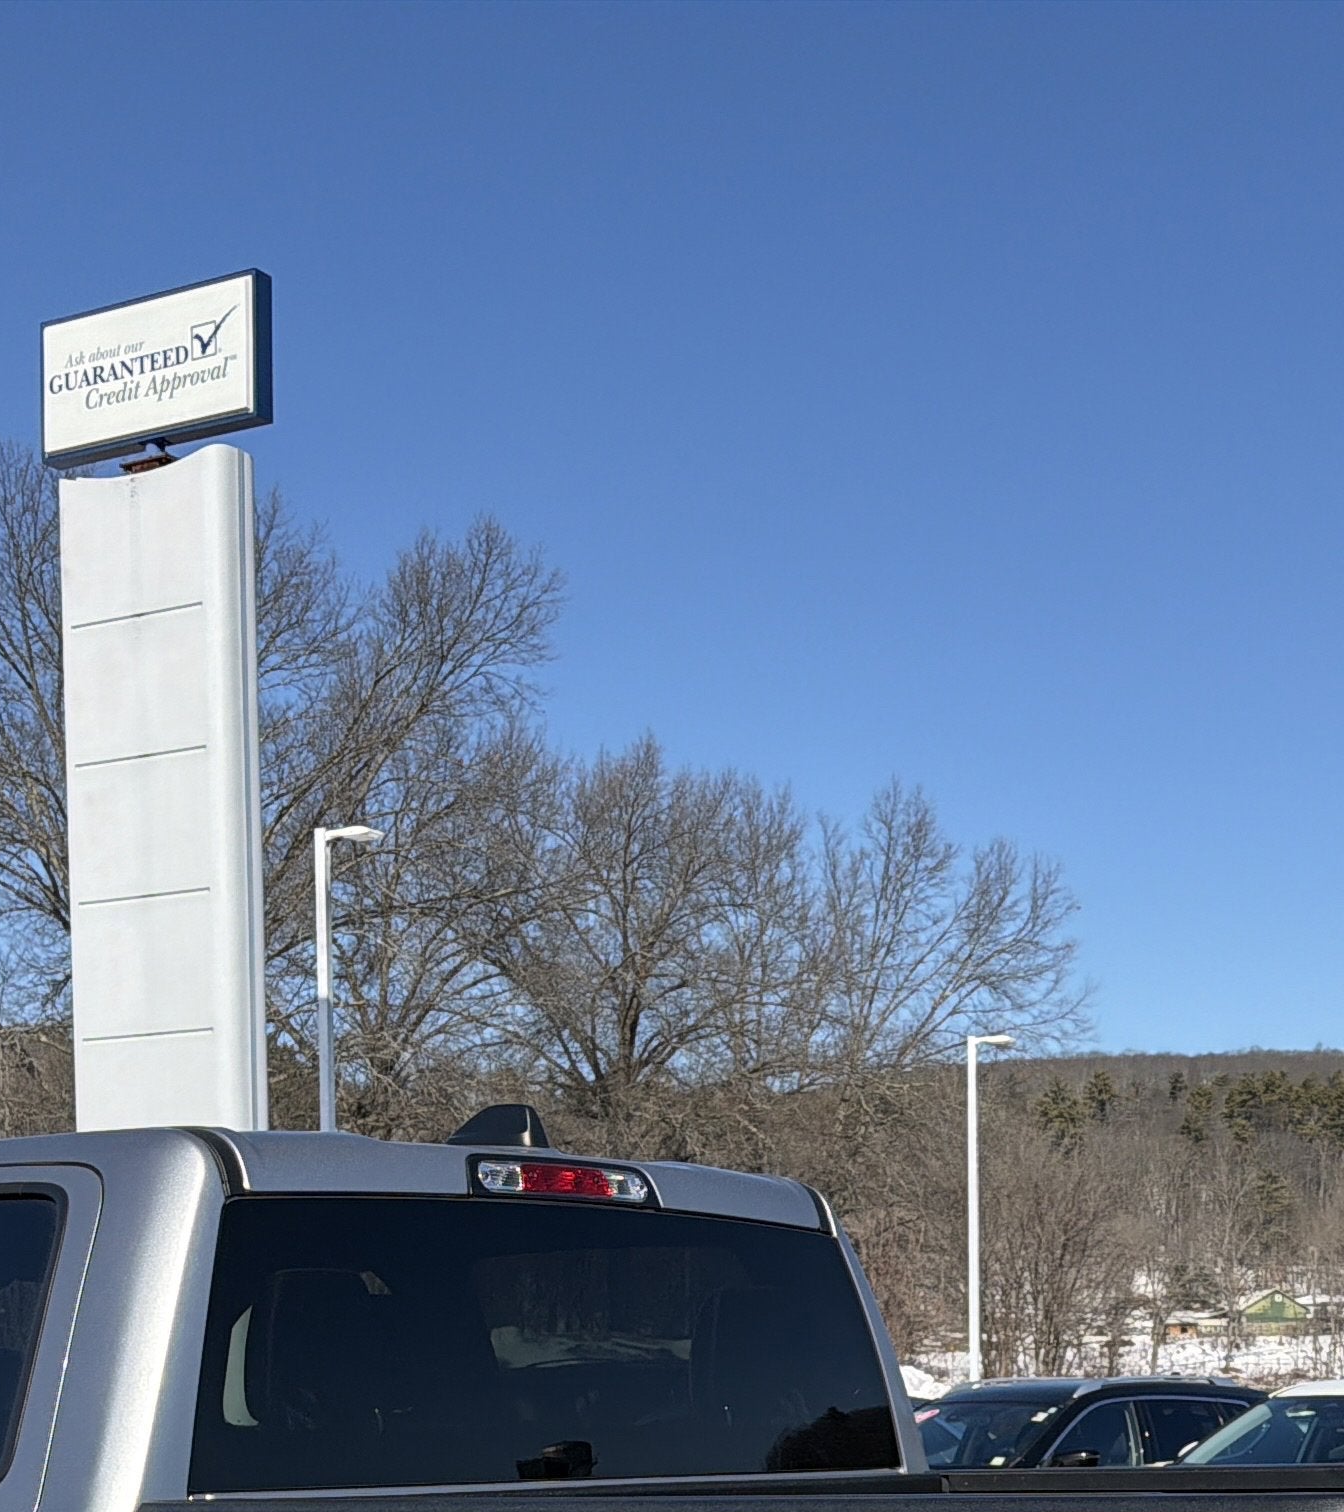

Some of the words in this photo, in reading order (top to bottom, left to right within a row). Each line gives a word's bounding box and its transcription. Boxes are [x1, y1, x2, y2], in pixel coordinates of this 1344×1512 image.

[49, 345, 189, 395] GUARANTEED
[64, 351, 85, 369] Ask
[88, 343, 121, 363] about
[124, 341, 145, 355] our
[85, 379, 141, 410] Credit
[144, 356, 229, 402] Approval
